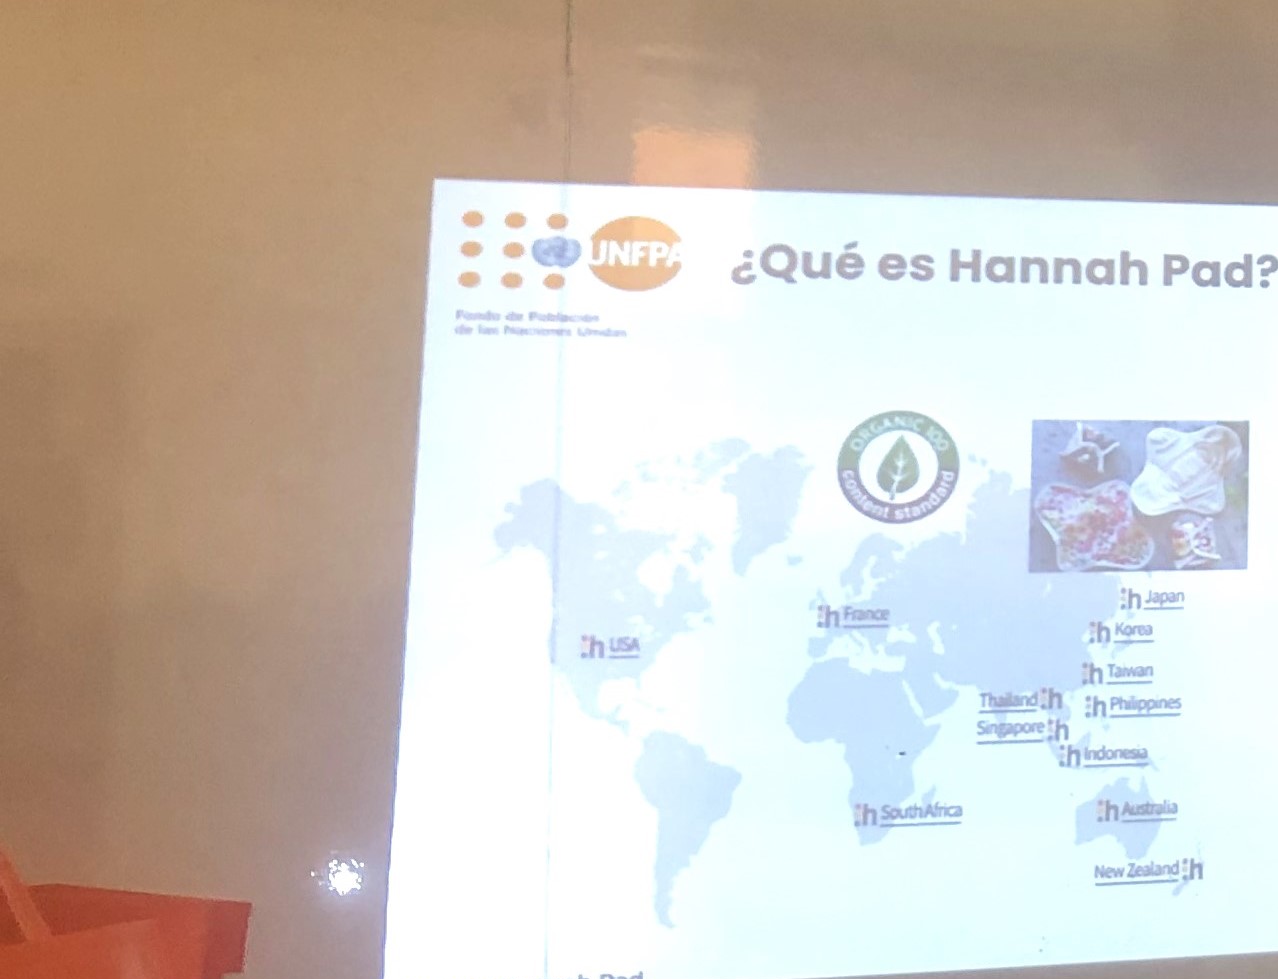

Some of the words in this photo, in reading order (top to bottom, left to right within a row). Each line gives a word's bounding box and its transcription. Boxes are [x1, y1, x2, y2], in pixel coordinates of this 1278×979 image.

[730, 240, 866, 286] ¿Qué
[877, 253, 935, 283] es
[948, 248, 1149, 287] Hannah
[1145, 590, 1185, 606] Japan
[843, 606, 889, 621] France
[1115, 622, 1153, 636] Korea
[1107, 664, 1153, 678] Taiwan
[980, 692, 1038, 708] Thailand
[1110, 696, 1181, 713] Philippines
[977, 720, 1045, 738] Singapore
[1084, 746, 1148, 760] Indonesia
[1122, 800, 1178, 816] Australia
[1094, 865, 1124, 879] New
[1127, 860, 1179, 878] Zealand
